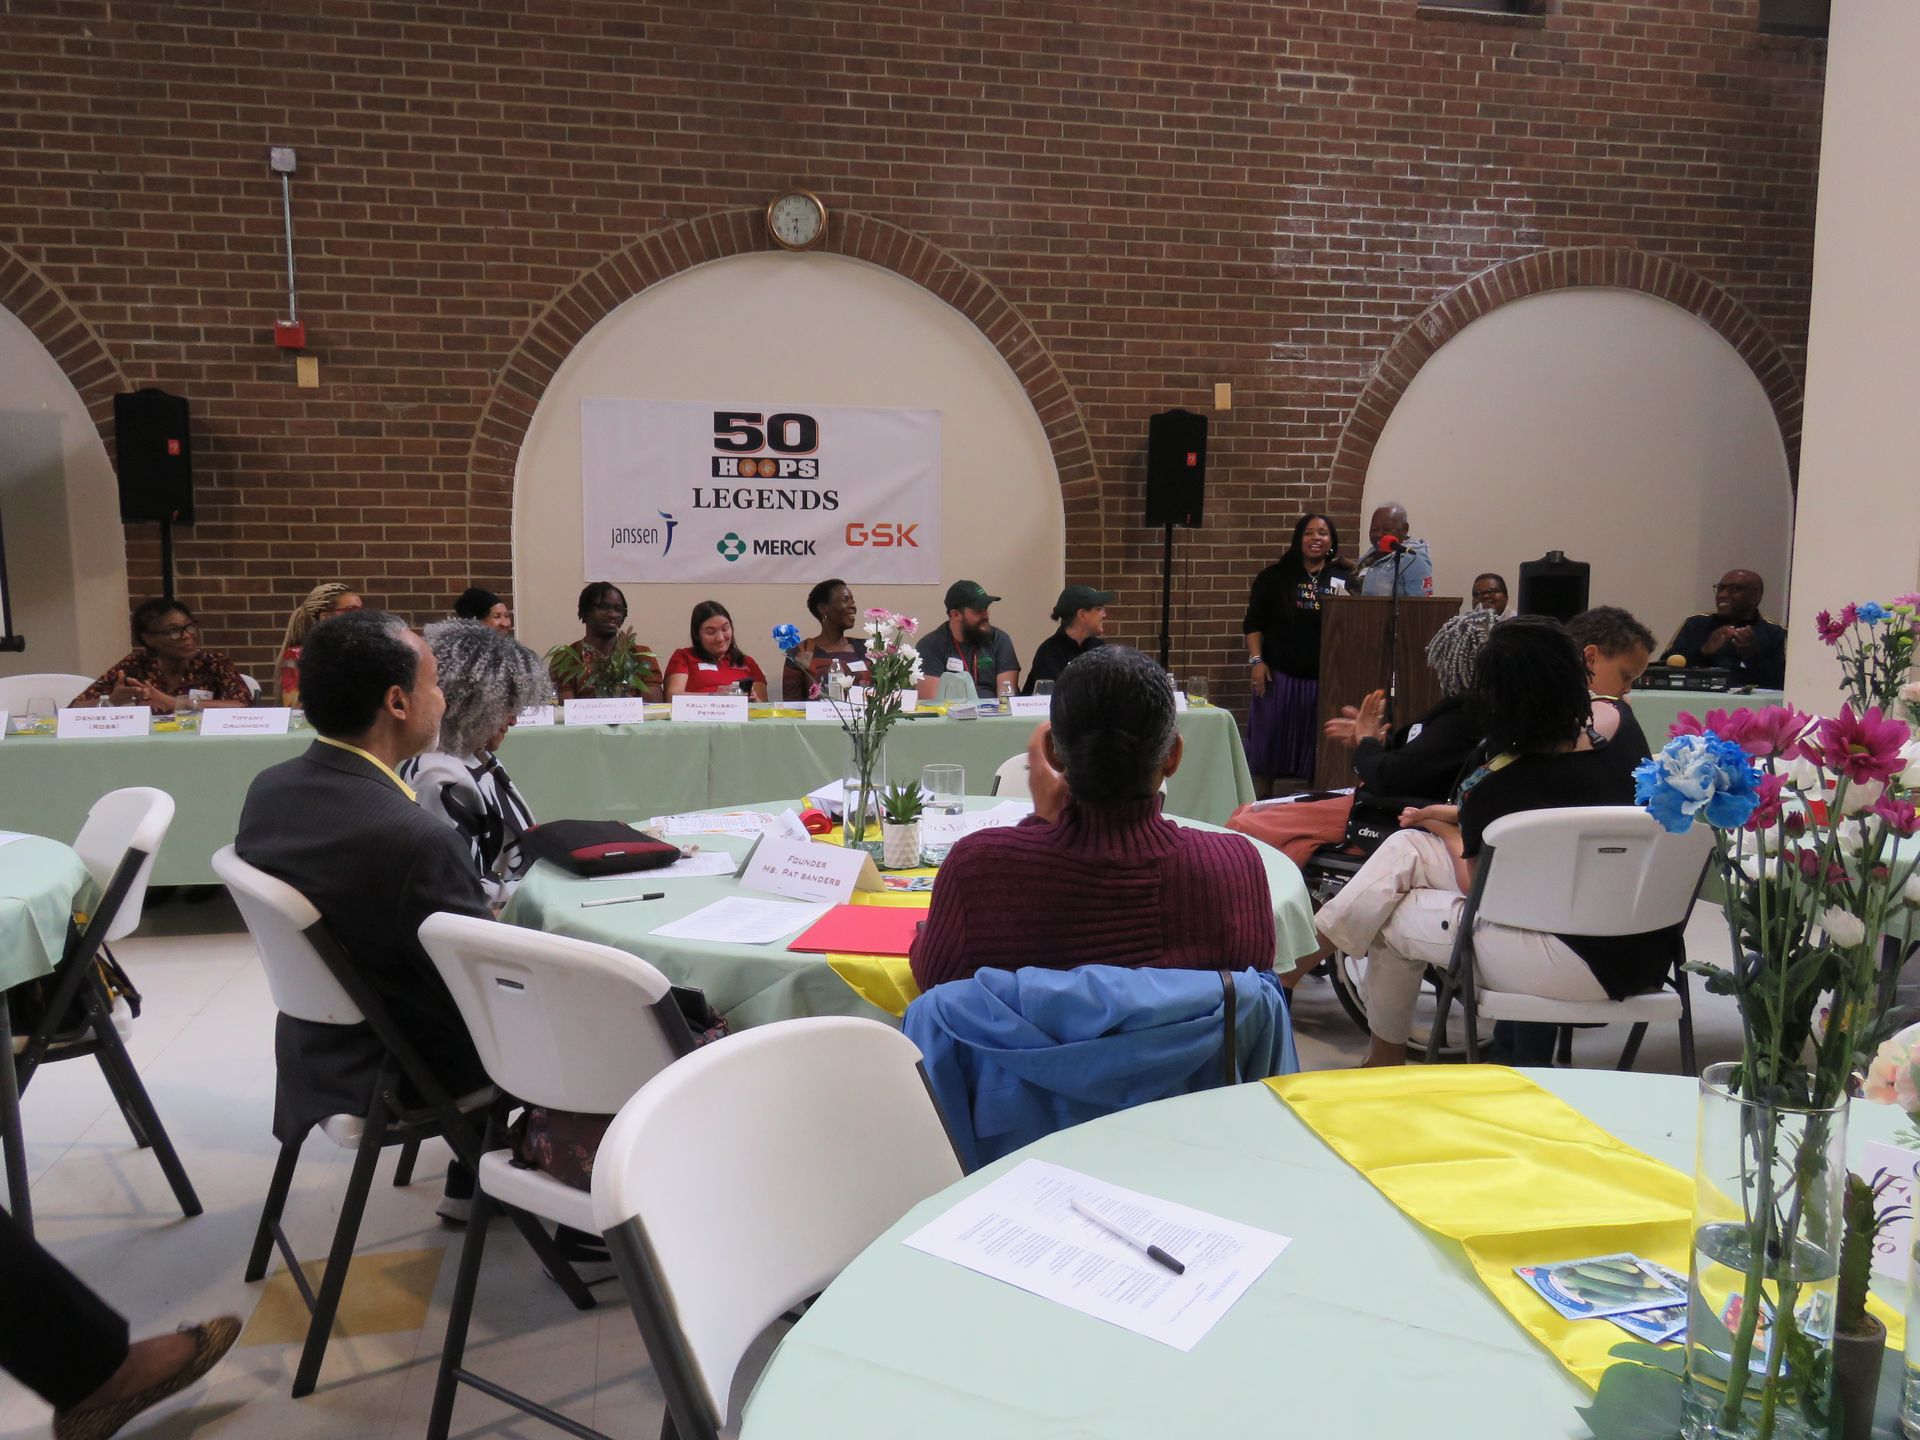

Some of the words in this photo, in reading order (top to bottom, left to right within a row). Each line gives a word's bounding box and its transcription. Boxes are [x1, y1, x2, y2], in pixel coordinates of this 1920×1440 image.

[713, 411, 819, 454] 50
[692, 488, 839, 511] LEGENDS
[846, 523, 919, 547] GSK
[753, 539, 816, 556] MERCK
[787, 855, 827, 868] FOUNDER
[781, 868, 799, 879] PAT
[800, 872, 841, 887] SANDERS
